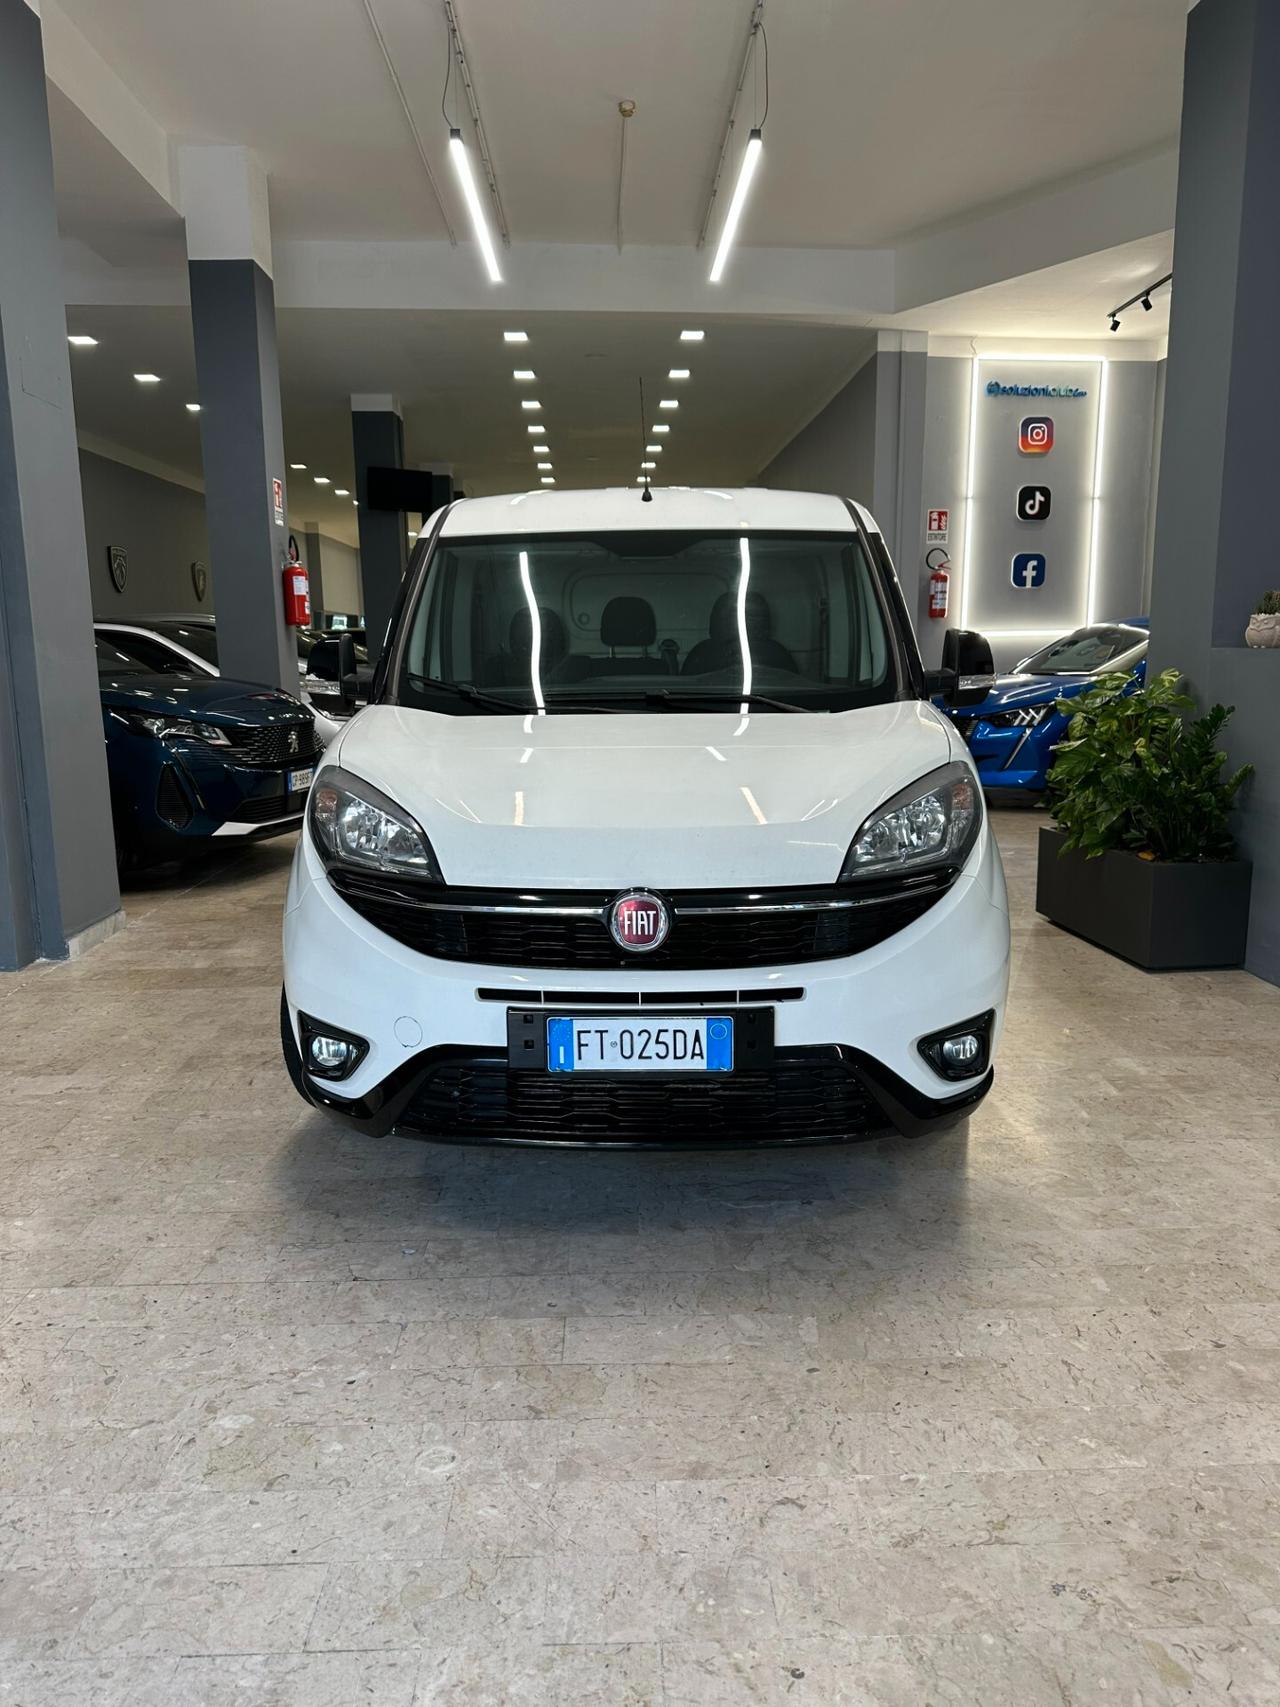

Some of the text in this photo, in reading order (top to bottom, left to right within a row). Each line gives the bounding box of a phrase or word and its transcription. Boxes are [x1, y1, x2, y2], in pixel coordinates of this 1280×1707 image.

[624, 910, 656, 936] FIAT
[577, 1028, 704, 1060] FT 025DA
